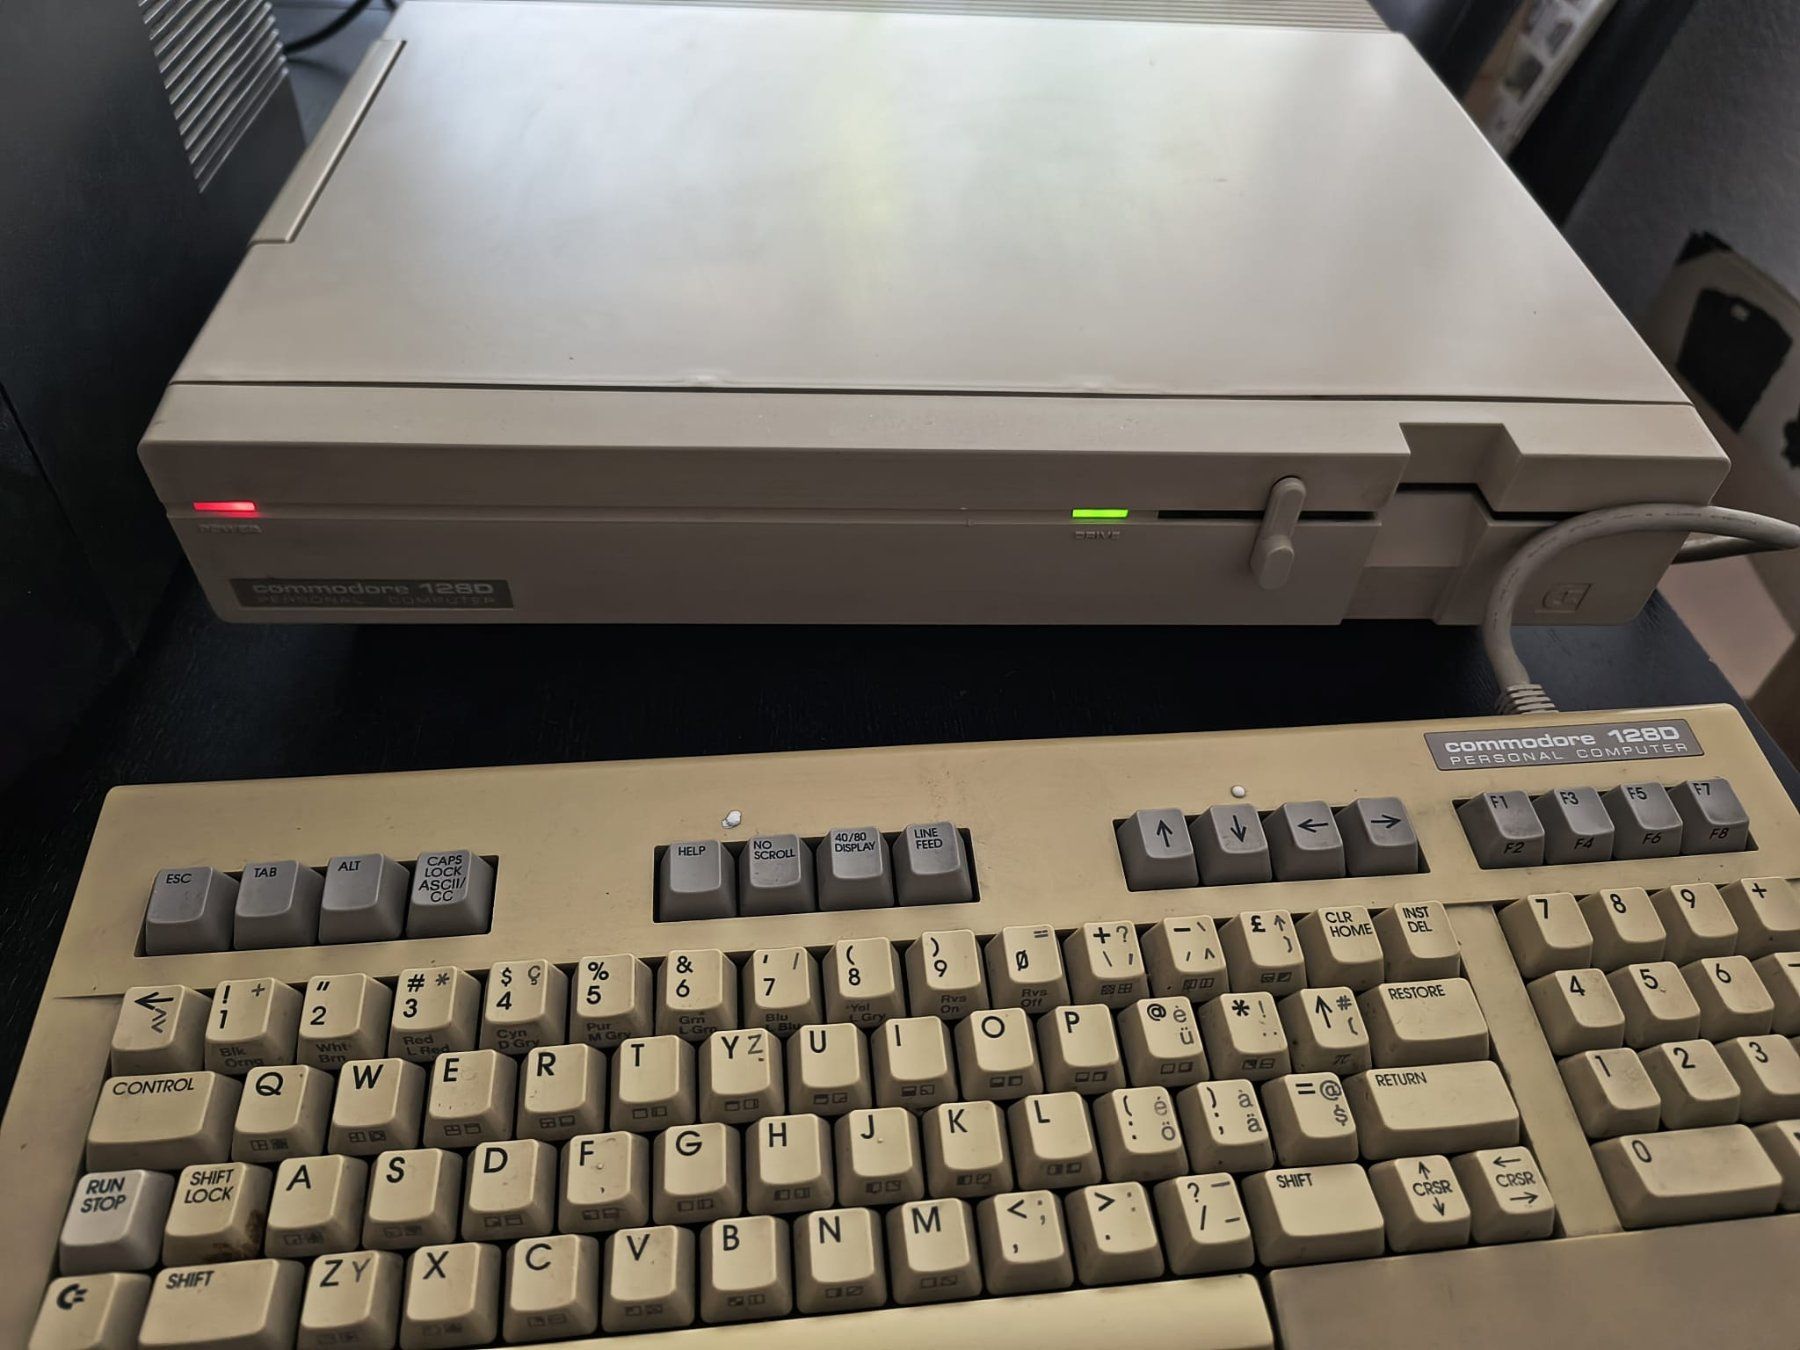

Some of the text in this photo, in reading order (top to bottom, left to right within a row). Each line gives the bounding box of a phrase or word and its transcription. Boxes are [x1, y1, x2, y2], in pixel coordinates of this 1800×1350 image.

[252, 582, 494, 596] commodore 128D
[1445, 726, 1679, 753] commodore 128D
[1450, 742, 1688, 766] PERSONAL COMPUTER
[1628, 787, 1648, 800] F5
[1695, 782, 1712, 796] F7
[1490, 796, 1508, 810] F1
[1560, 791, 1579, 806] F3
[835, 832, 867, 843] 40/80
[914, 828, 938, 838] LINE
[1642, 833, 1661, 844] F6
[1710, 828, 1731, 840] F8
[678, 846, 706, 856] HELP
[753, 840, 772, 849] NO
[834, 841, 875, 852] DISPLAY
[916, 838, 943, 849] FEED
[1504, 841, 1525, 853] F2
[1575, 837, 1595, 849] F4
[427, 855, 463, 867] CAPS
[754, 849, 796, 860] SCROLL
[254, 866, 277, 878] TAB
[337, 860, 361, 872] ALT
[424, 866, 463, 877] LOCK
[166, 873, 192, 884] ESC
[419, 878, 466, 891] ASCII/
[430, 891, 454, 903] CC
[1609, 893, 1627, 914] 8
[1680, 888, 1696, 909] 9
[1325, 911, 1352, 923] CLR
[1402, 906, 1430, 919] INST
[1535, 898, 1549, 919] 7
[1251, 915, 1266, 933] £
[1330, 923, 1373, 938] HOME
[1408, 920, 1432, 933] DEL
[588, 961, 609, 981] %
[676, 955, 694, 974] &
[934, 959, 947, 977] 9
[1715, 963, 1732, 984] 6
[500, 966, 513, 987] $
[848, 968, 861, 986] 8
[1569, 975, 1585, 996] 4
[1639, 968, 1659, 990] 5
[586, 985, 601, 1005] 5
[676, 979, 690, 997] 6
[763, 978, 775, 997] 7
[1022, 988, 1048, 997] Rvs
[1388, 984, 1446, 1000] RESTORE
[496, 991, 512, 1010] 4
[941, 994, 967, 1003] Rvs
[1021, 998, 1043, 1007] Off
[310, 1006, 327, 1026] 2
[403, 999, 418, 1018] 3
[765, 1013, 788, 1022] Blu
[861, 1012, 886, 1022] Gry
[941, 1004, 960, 1013] On
[1147, 1003, 1166, 1021] @
[219, 1010, 228, 1029] 1
[586, 1023, 611, 1032] Pur
[679, 1015, 705, 1024] Grn
[981, 1015, 1006, 1039] O
[1064, 1011, 1080, 1033] P
[403, 1036, 434, 1046] Red
[496, 1028, 528, 1041] Cyn
[588, 1033, 602, 1042] M
[810, 1030, 827, 1053] U
[220, 1047, 244, 1056] Blk
[316, 1041, 346, 1053] Wht
[631, 1044, 645, 1067] T
[721, 1034, 764, 1059] Y Z
[1749, 1041, 1769, 1063] 3
[319, 1053, 345, 1063] Brn
[536, 1052, 556, 1077] R
[1594, 1054, 1611, 1078] 1
[1673, 1046, 1696, 1069] 2
[353, 1065, 384, 1090] W
[443, 1058, 459, 1082] E
[113, 1078, 194, 1095] CONTROL
[256, 1072, 283, 1096] Q
[1375, 1072, 1428, 1087] RETURN
[1319, 1080, 1342, 1100] @
[948, 1108, 968, 1133] K
[1033, 1099, 1051, 1124] L
[1333, 1104, 1348, 1126] $
[768, 1122, 788, 1147] H
[861, 1114, 874, 1139] J
[676, 1130, 702, 1156] G
[1631, 1139, 1653, 1163] 0
[483, 1147, 508, 1173] D
[579, 1140, 594, 1166] F
[189, 1168, 234, 1186] SHIFT
[286, 1165, 311, 1191] A
[386, 1157, 405, 1183] S
[86, 1177, 125, 1195] RUN
[1276, 1173, 1313, 1188] SHIFT
[1412, 1180, 1453, 1197] CRSR
[1495, 1171, 1536, 1188] CRSR
[184, 1186, 234, 1204] LOCK
[1187, 1182, 1200, 1203] ?
[80, 1195, 127, 1213] STOP
[911, 1206, 942, 1234] M
[723, 1225, 740, 1251] B
[819, 1216, 842, 1243] N
[525, 1243, 551, 1270] C
[626, 1234, 650, 1261] V
[319, 1259, 370, 1287] Z Y
[422, 1251, 449, 1279] X
[165, 1270, 214, 1290] SHIFT
